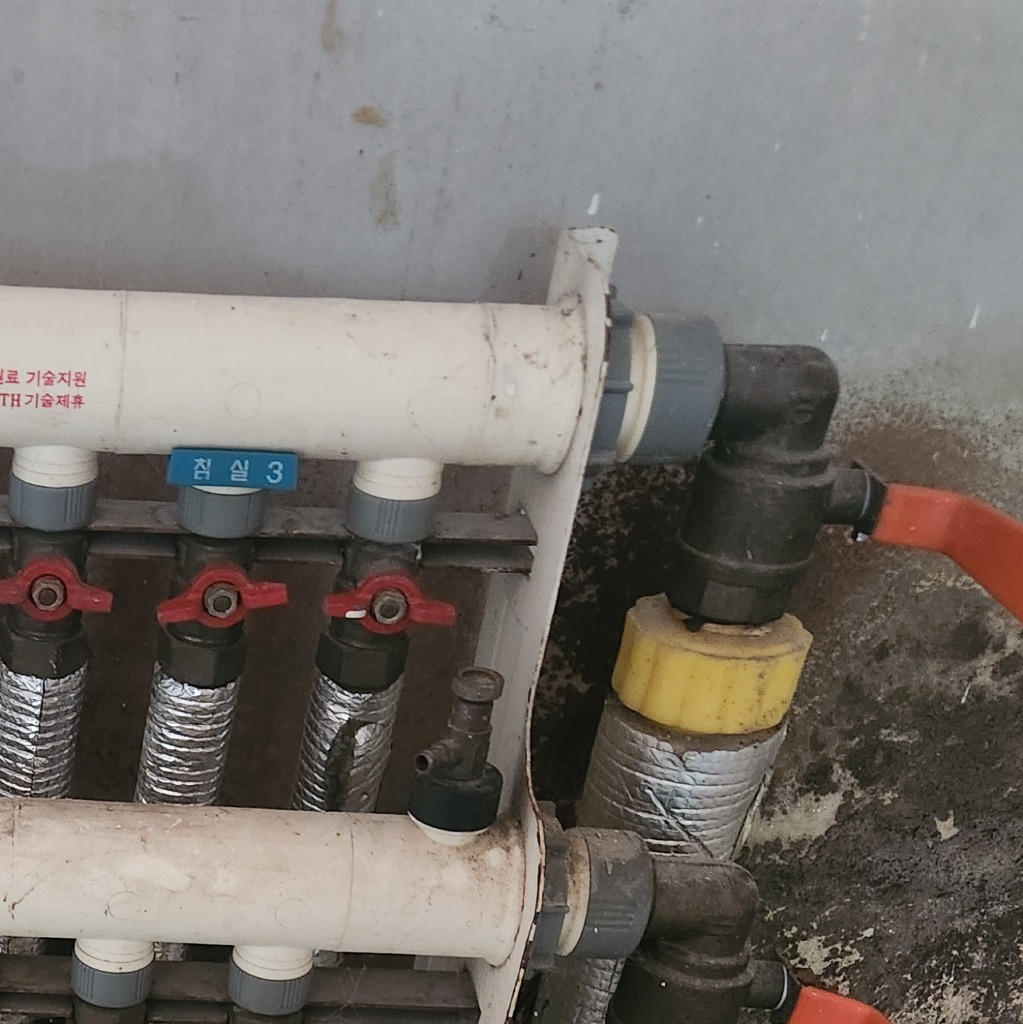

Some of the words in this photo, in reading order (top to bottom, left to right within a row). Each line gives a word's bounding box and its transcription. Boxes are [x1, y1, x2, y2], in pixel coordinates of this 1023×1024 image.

[26, 370, 87, 387] 기술지원
[24, 392, 85, 409] 기술제휴
[266, 460, 284, 484] 3
